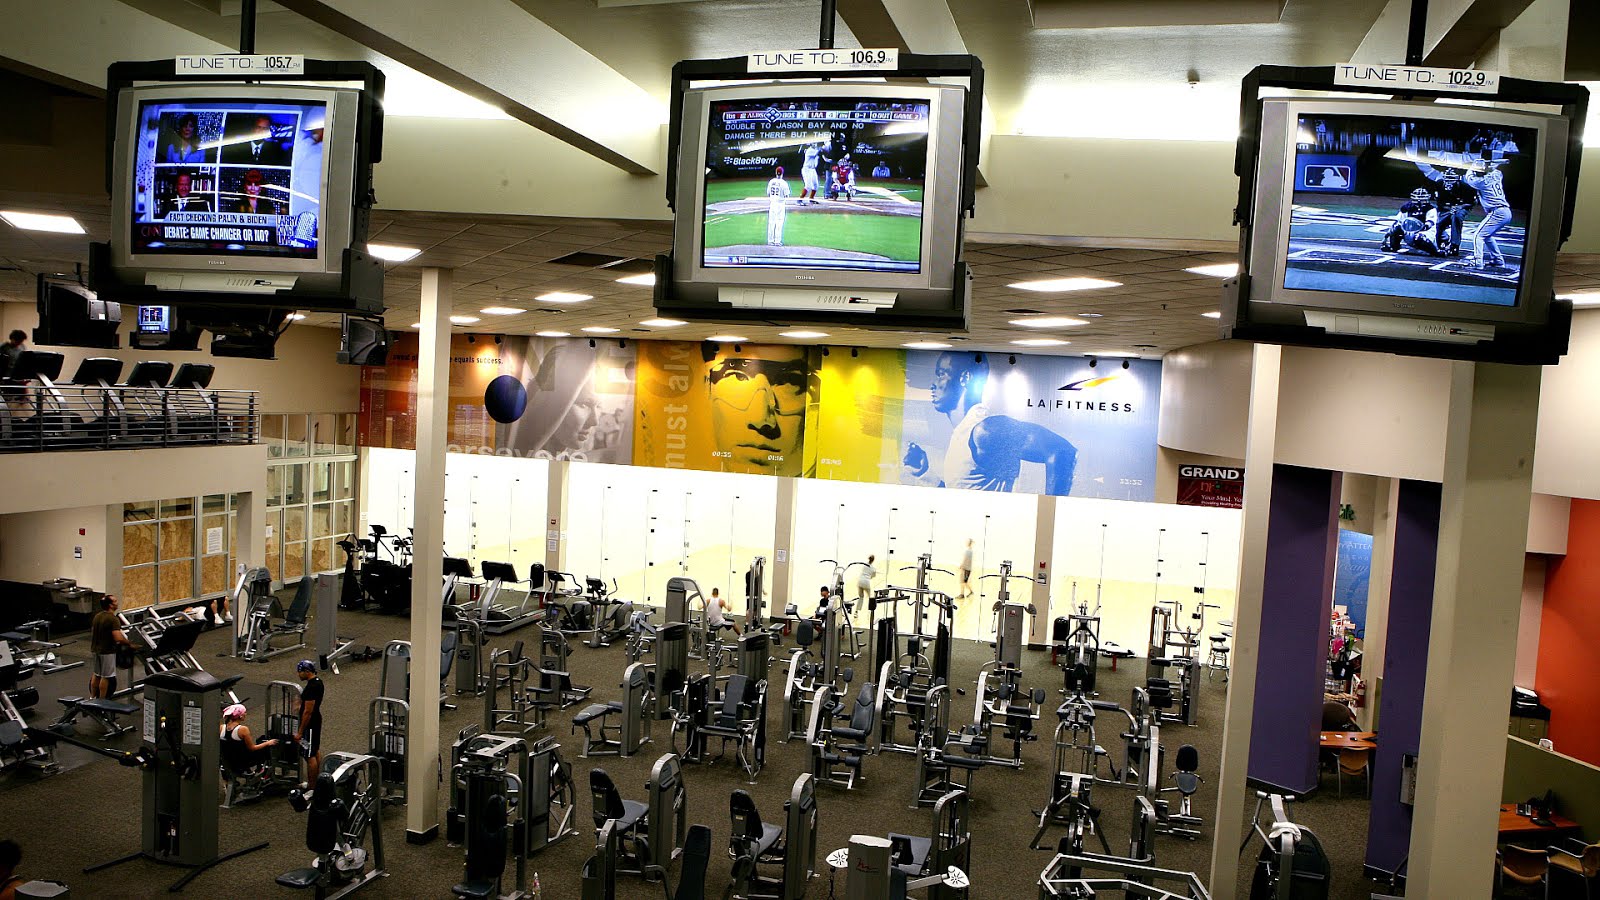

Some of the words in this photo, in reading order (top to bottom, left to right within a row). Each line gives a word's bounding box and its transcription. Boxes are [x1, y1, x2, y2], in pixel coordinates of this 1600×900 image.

[180, 57, 224, 69] TUNE
[228, 57, 254, 69] TO:
[264, 56, 292, 69] 105.7
[752, 53, 803, 65] TUNE
[809, 53, 838, 64] TO:
[850, 50, 886, 64] 106.9
[1341, 66, 1397, 81] TUNE
[1403, 69, 1435, 83] TO:
[1448, 71, 1486, 86] 102.9
[725, 122, 756, 130] DOUBLE
[776, 121, 803, 129] JASON
[808, 121, 825, 129] BAY
[760, 131, 786, 139] THERE
[791, 131, 808, 139] BUT
[814, 131, 835, 139] THEN
[733, 156, 778, 165] BlackBerry
[1492, 183, 1502, 196] 18
[169, 212, 184, 222] FACT
[185, 213, 217, 223] CHECKING
[218, 214, 238, 223] PALIN
[240, 215, 245, 223] &
[247, 216, 267, 224] BIDEN
[164, 226, 189, 239] DEBATE:
[190, 227, 210, 240] GAME
[210, 228, 242, 241] CHANGER
[243, 229, 253, 241] OR
[254, 230, 270, 242] NO?
[454, 356, 475, 364] equals
[476, 356, 504, 365] success.
[1027, 398, 1046, 408] LA
[1056, 400, 1135, 413] FITNESS
[1180, 466, 1240, 480] GRAND
